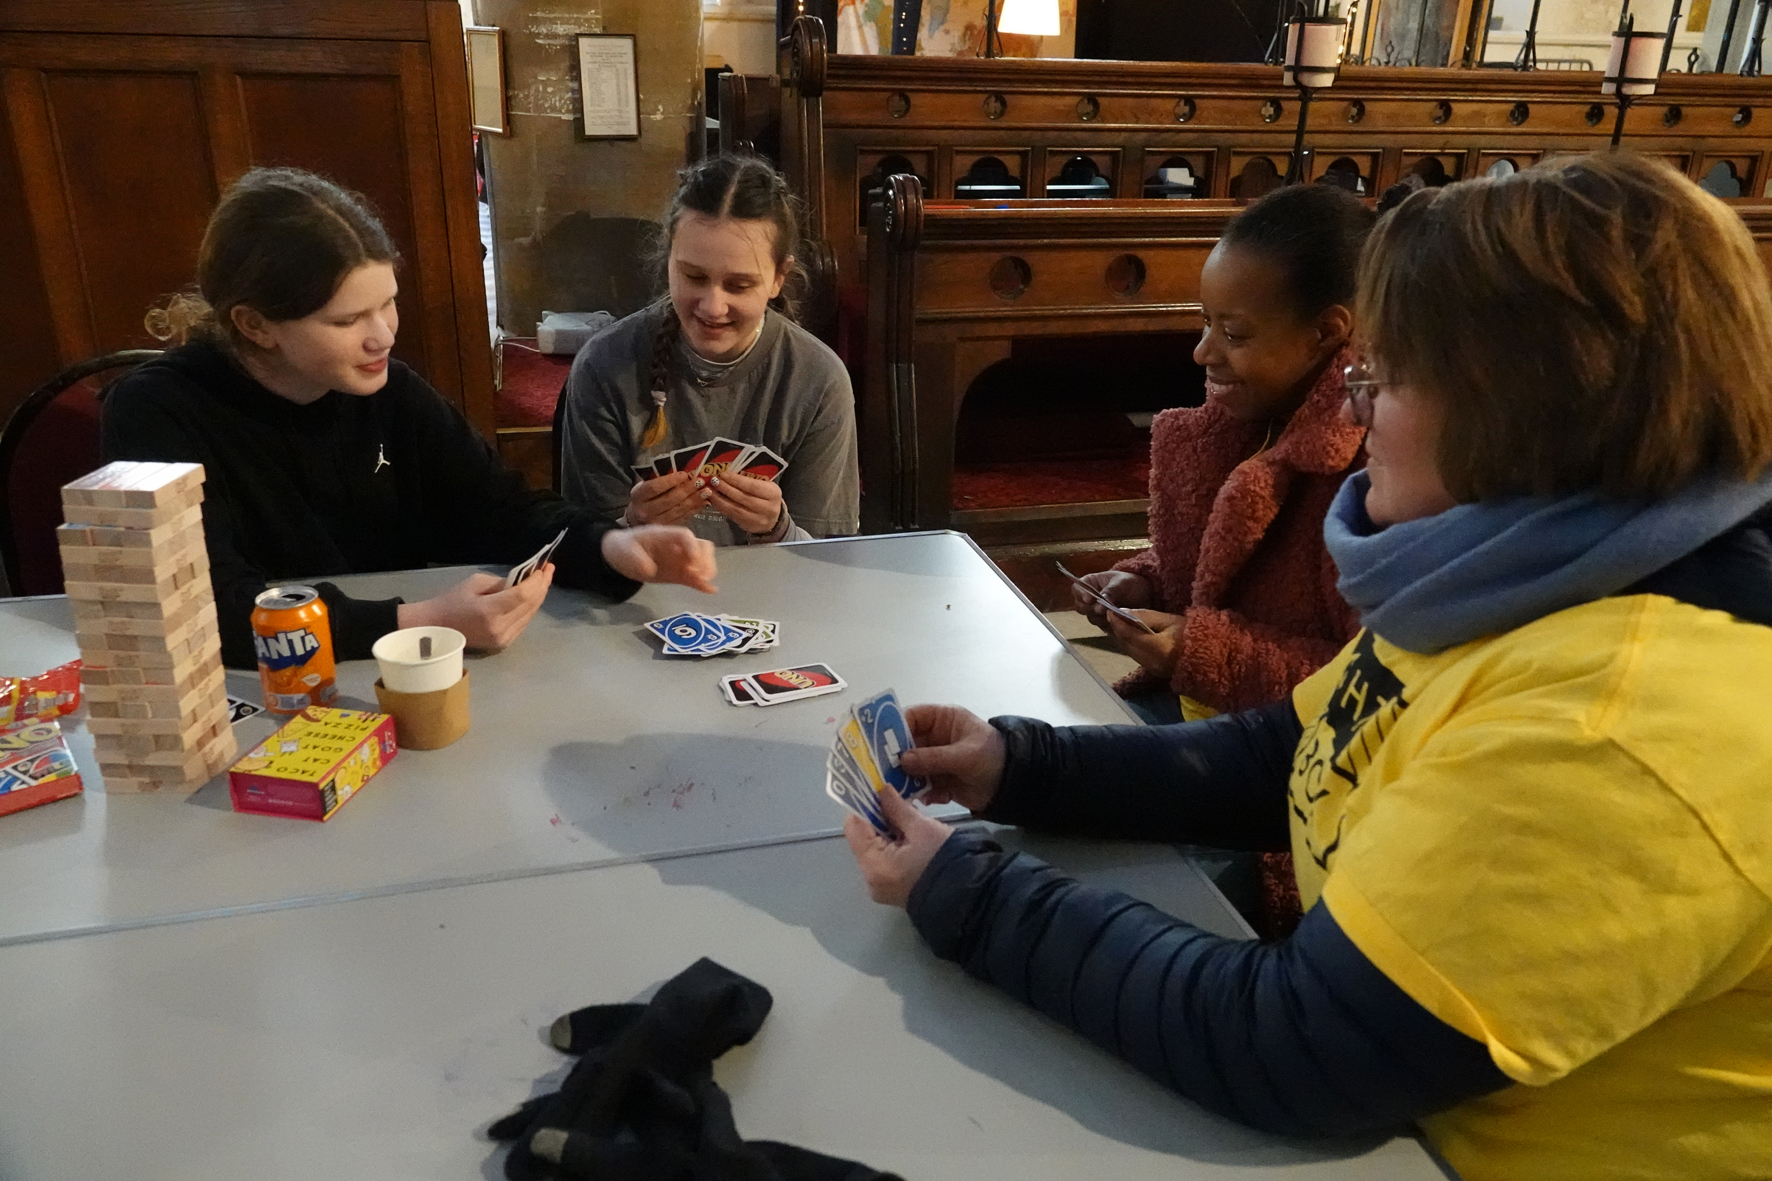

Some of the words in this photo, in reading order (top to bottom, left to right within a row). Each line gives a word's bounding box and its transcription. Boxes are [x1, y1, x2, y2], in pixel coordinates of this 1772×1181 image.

[701, 462, 732, 477] NO
[774, 669, 817, 689] UNO
[324, 721, 370, 732] PIZZA
[306, 731, 356, 743] CHEESE
[302, 743, 343, 753] GOAT
[303, 756, 331, 766] CAT
[276, 766, 317, 778] TACO
